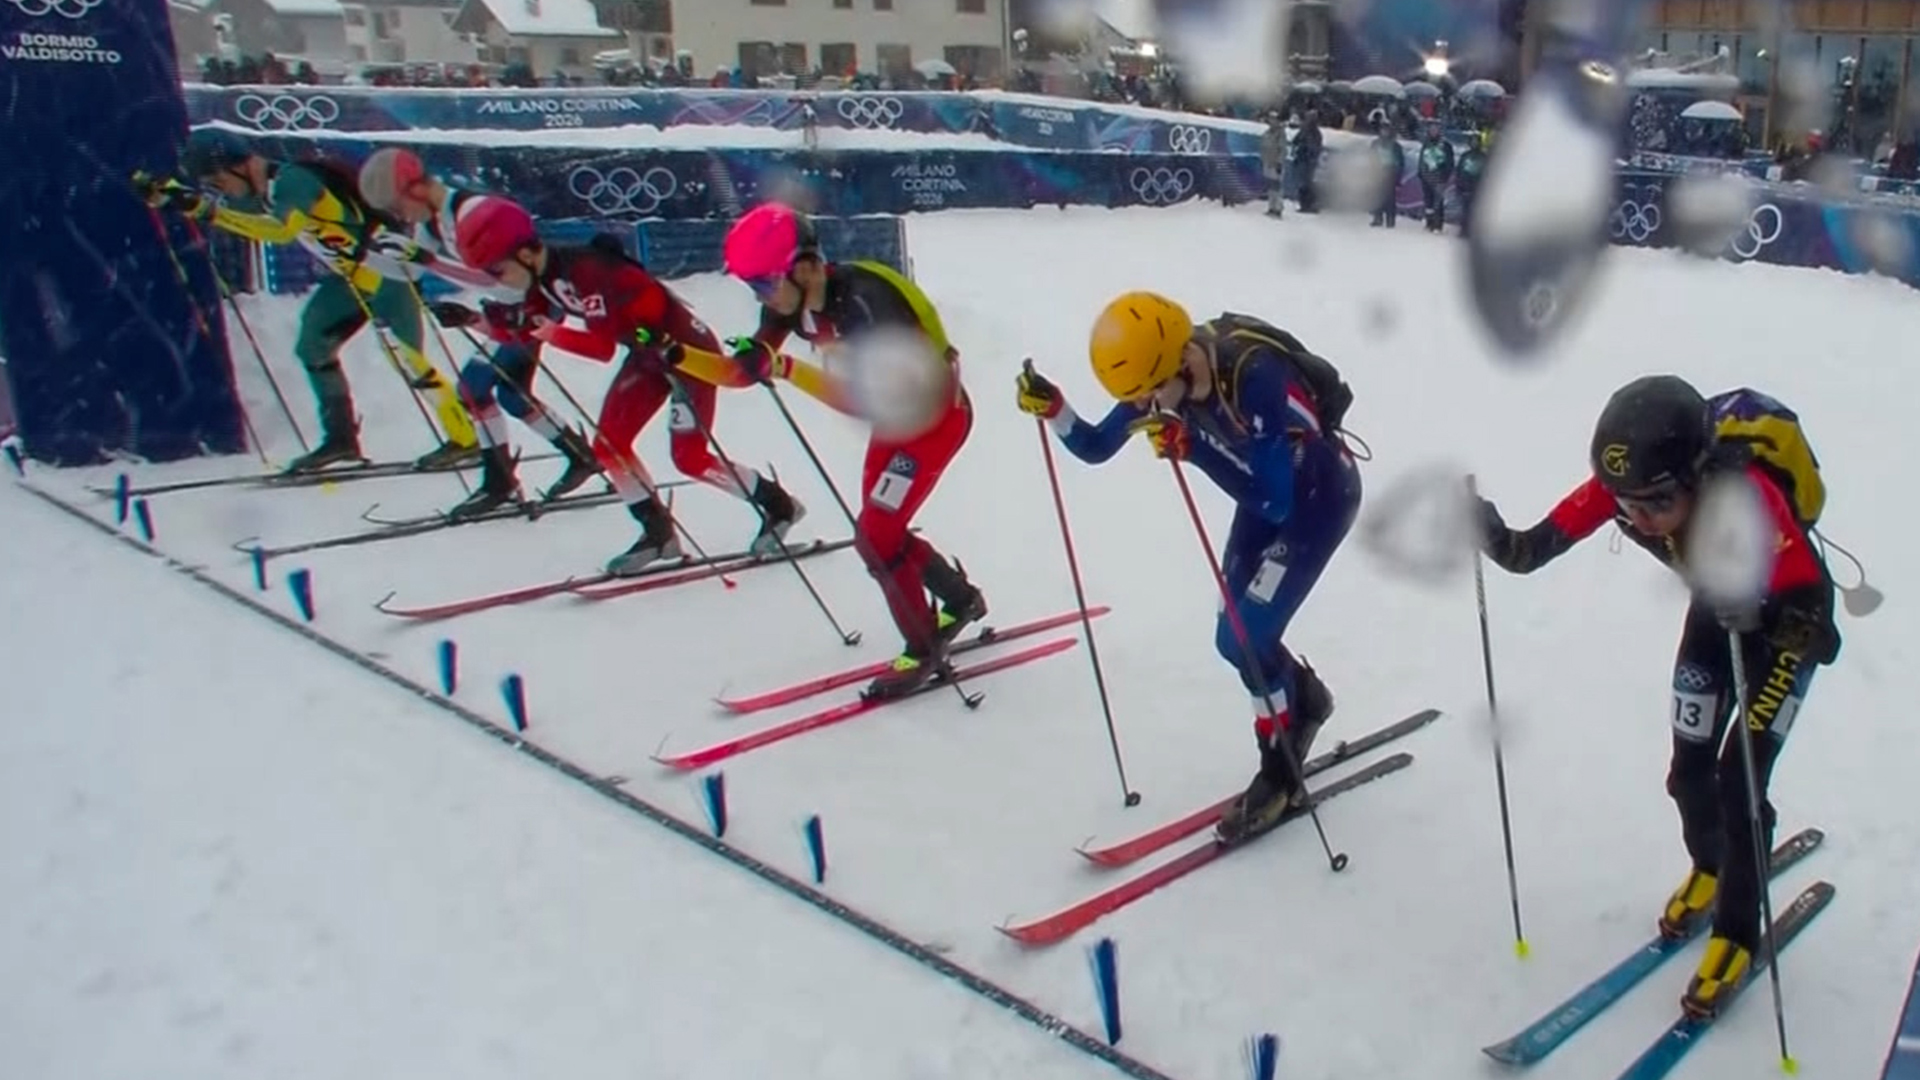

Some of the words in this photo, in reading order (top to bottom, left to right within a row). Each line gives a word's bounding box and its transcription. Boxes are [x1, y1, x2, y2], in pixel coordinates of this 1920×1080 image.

[19, 33, 98, 49] BORMIO
[1, 45, 121, 63] VALDISOTTO
[477, 100, 559, 113] MILANO
[562, 98, 643, 113] CORTINA
[545, 114, 583, 127] 2026
[902, 178, 967, 192] CORTINA
[671, 408, 681, 425] 2
[879, 478, 890, 496] 1
[1749, 651, 1801, 731] CHINA
[1675, 696, 1702, 728] 13
